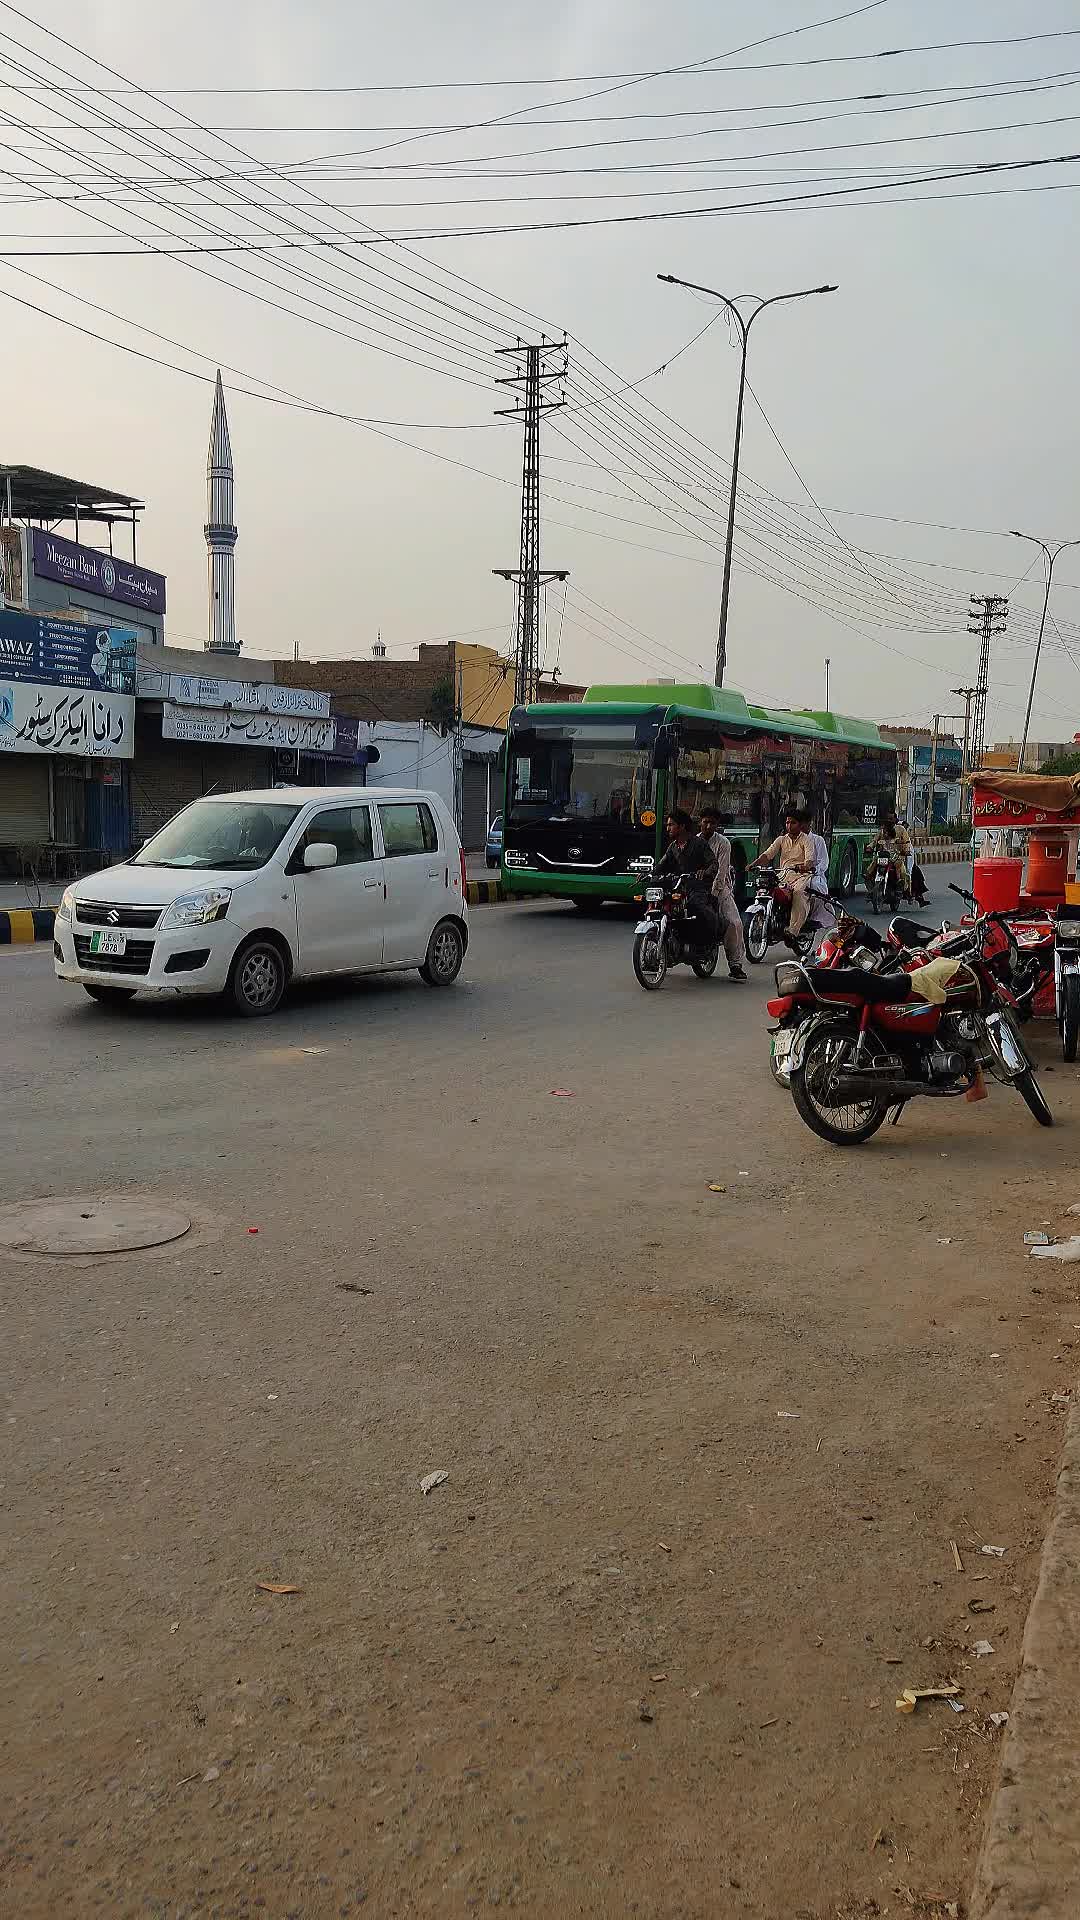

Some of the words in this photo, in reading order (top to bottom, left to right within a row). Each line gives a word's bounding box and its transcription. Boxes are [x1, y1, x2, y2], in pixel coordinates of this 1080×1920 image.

[46, 542, 78, 570] Meezan
[79, 555, 99, 577] Bank
[101, 942, 118, 953] 7878
